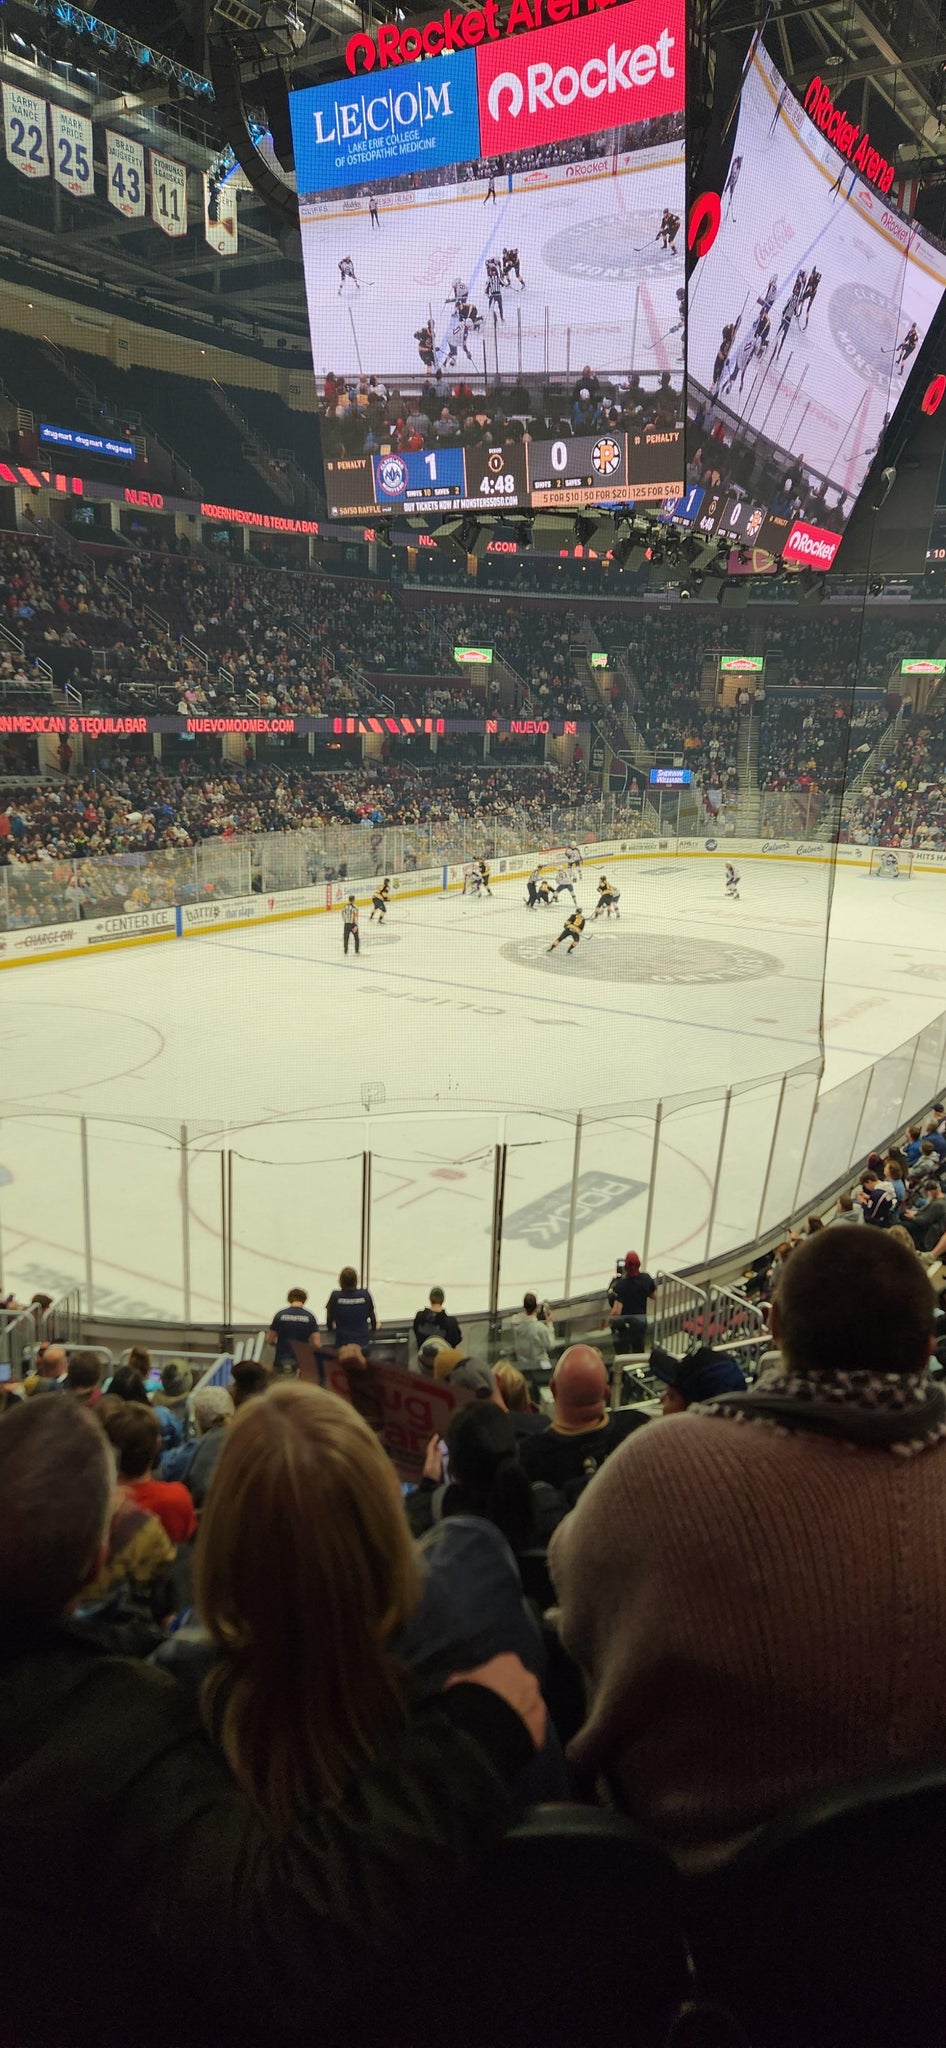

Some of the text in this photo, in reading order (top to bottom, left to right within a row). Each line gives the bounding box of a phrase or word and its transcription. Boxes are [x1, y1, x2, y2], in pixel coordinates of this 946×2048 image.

[377, 0, 500, 67] Rocket
[527, 27, 675, 113] Rocket
[12, 92, 38, 111] LARRY
[12, 104, 39, 122] NANCE
[61, 114, 83, 130] MARK
[10, 117, 44, 164] 22
[61, 125, 84, 141] PRICE
[348, 130, 420, 154] LAKE ERIE COLLEGE
[813, 84, 895, 193] Rocket Arena
[115, 139, 135, 154] BRAD
[335, 137, 436, 168] OF OSTEOPATHIC MEDICINE
[59, 138, 89, 181] 25
[575, 161, 608, 176] Rocket
[111, 162, 141, 203] 43
[159, 183, 180, 222] 11
[646, 432, 679, 444] PENALTY
[337, 459, 366, 470] PENALTY
[551, 441, 567, 471] 0
[424, 453, 437, 481] 1
[480, 475, 515, 494] 4:48
[543, 485, 680, 503] 5 FOR $10 50 FOR $20 125 FOR $40
[124, 487, 164, 509] NUEVO
[403, 502, 415, 512] BUY
[416, 501, 438, 511] TICKETS
[439, 500, 452, 510] NOW
[453, 499, 460, 509] AT
[686, 489, 697, 512] 1
[200, 503, 232, 521] MODERN
[232, 509, 262, 527] MEXICAN
[270, 516, 301, 533] TEQUILA
[301, 520, 319, 534] BAR
[358, 505, 381, 514] RAFFLE
[798, 531, 836, 561] Rocket
[12, 715, 66, 733] MEXICAN
[69, 716, 79, 733] &
[79, 717, 125, 734] TEQUILA
[126, 718, 147, 733] BAR
[187, 718, 294, 733] NUEVOMODMEX.COM
[511, 720, 549, 734] NUEVO
[762, 842, 790, 854] Culver's
[796, 844, 824, 856] Culver's
[105, 914, 149, 933] CENTER
[151, 911, 168, 925] ICE
